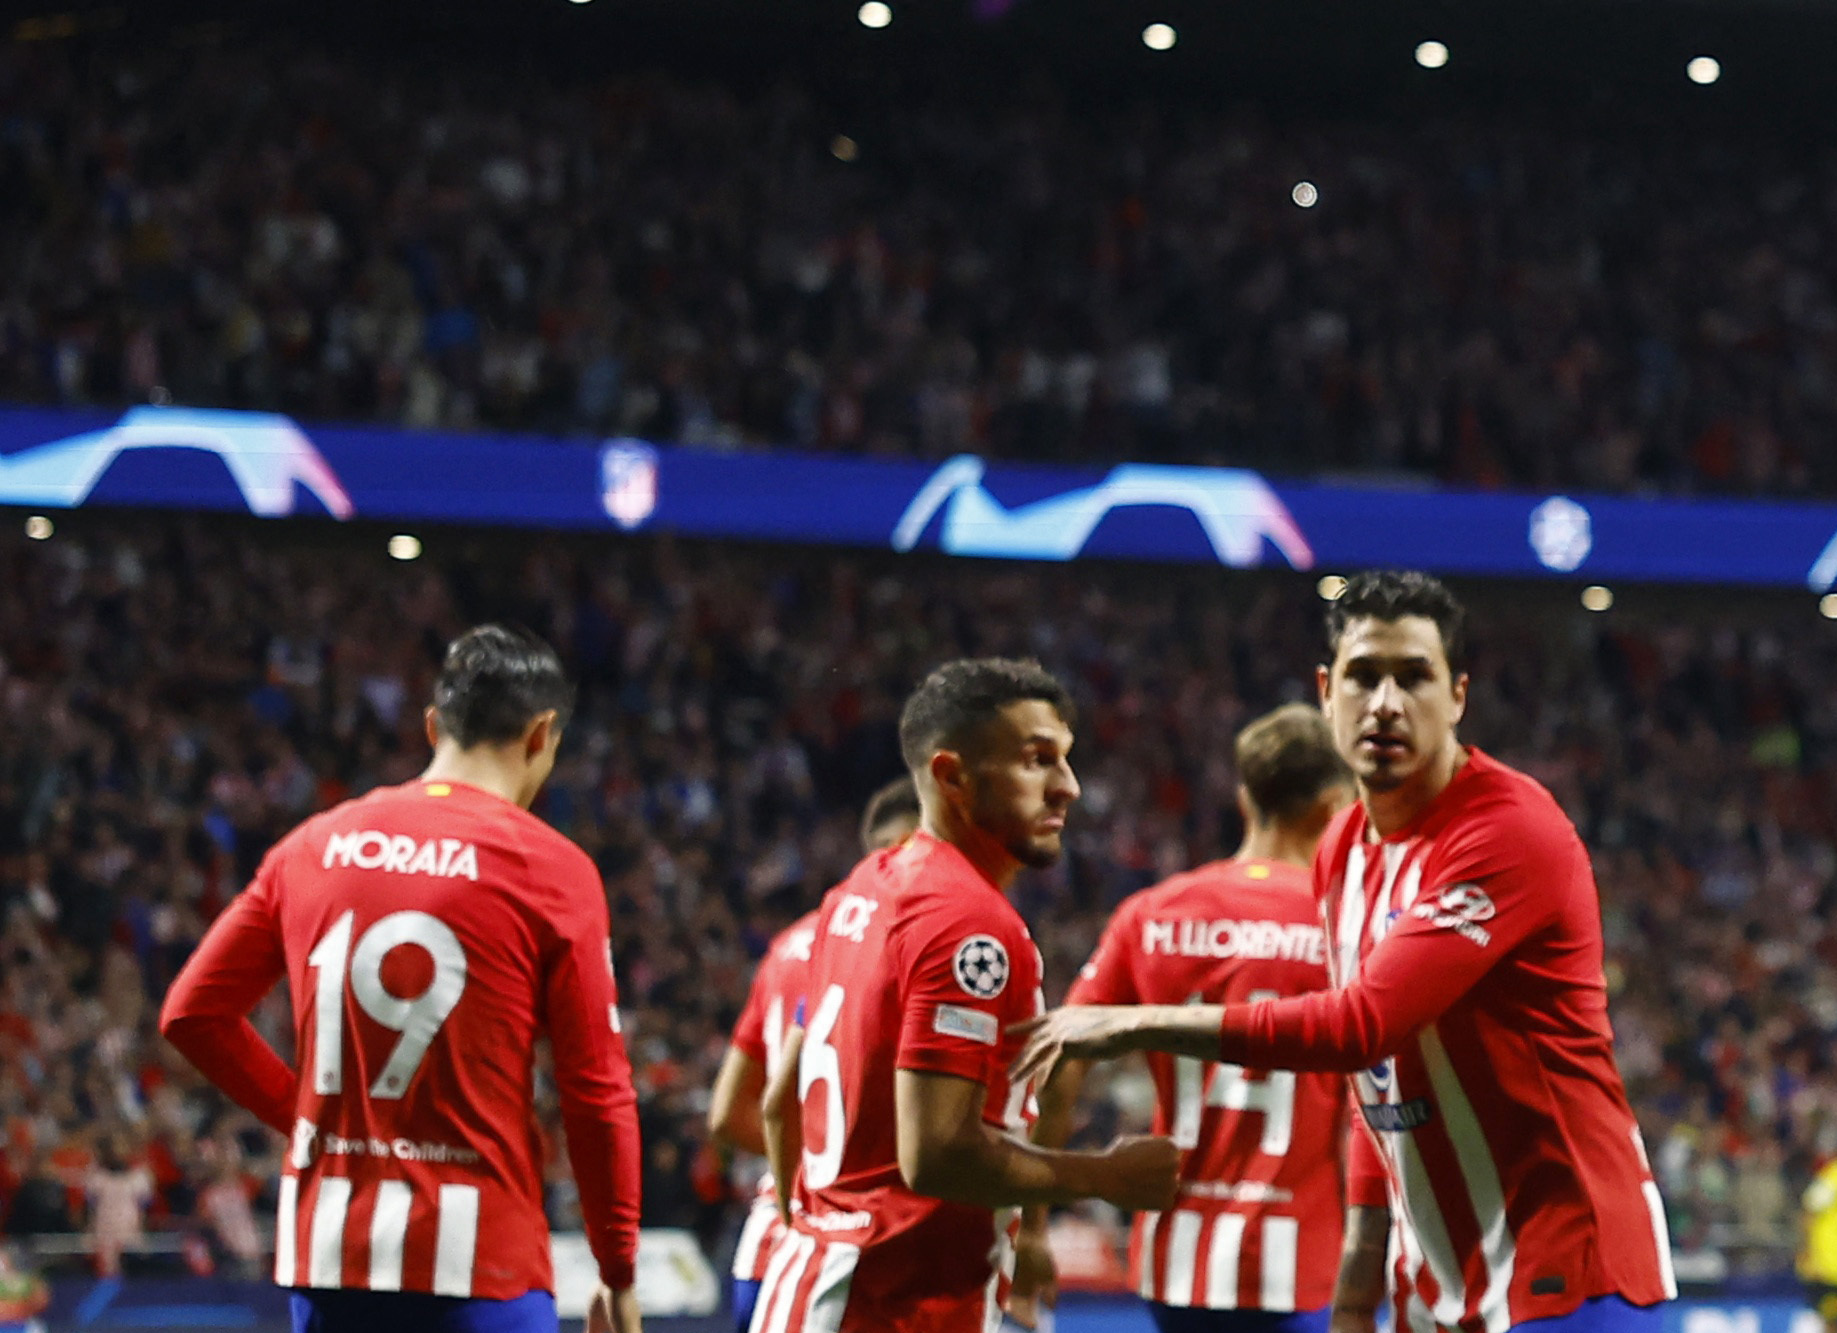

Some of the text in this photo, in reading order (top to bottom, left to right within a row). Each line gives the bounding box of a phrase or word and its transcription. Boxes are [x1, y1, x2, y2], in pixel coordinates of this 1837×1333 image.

[322, 829, 479, 882] MORATA
[308, 908, 467, 1099] 19
[798, 983, 846, 1191] 6
[391, 1136, 481, 1165] Children
